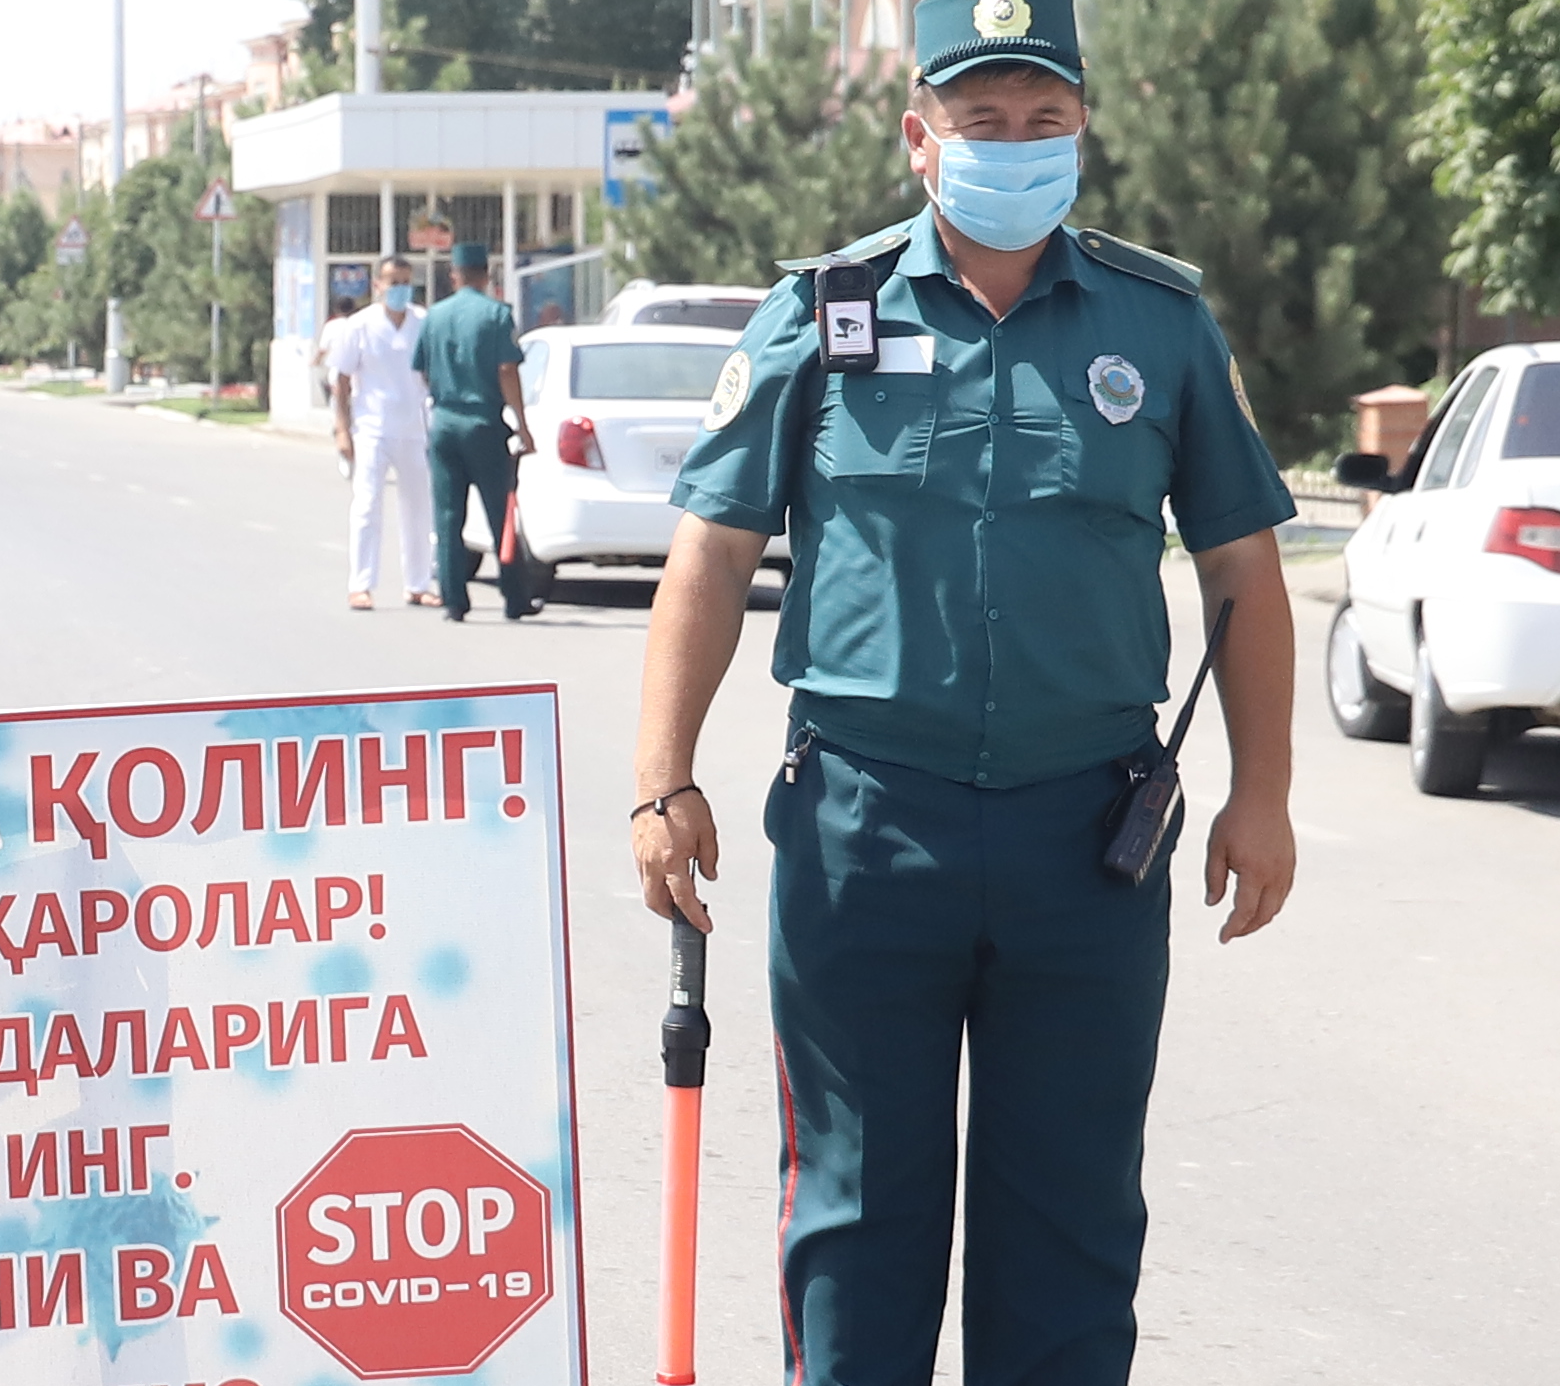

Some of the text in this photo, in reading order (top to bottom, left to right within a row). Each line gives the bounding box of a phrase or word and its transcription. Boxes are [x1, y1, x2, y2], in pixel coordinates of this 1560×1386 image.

[31, 729, 526, 861] ҚОЛИНГ!
[306, 1186, 516, 1266] STOP
[119, 1244, 240, 1321] ВА
[302, 1270, 532, 1310] COVID-19
